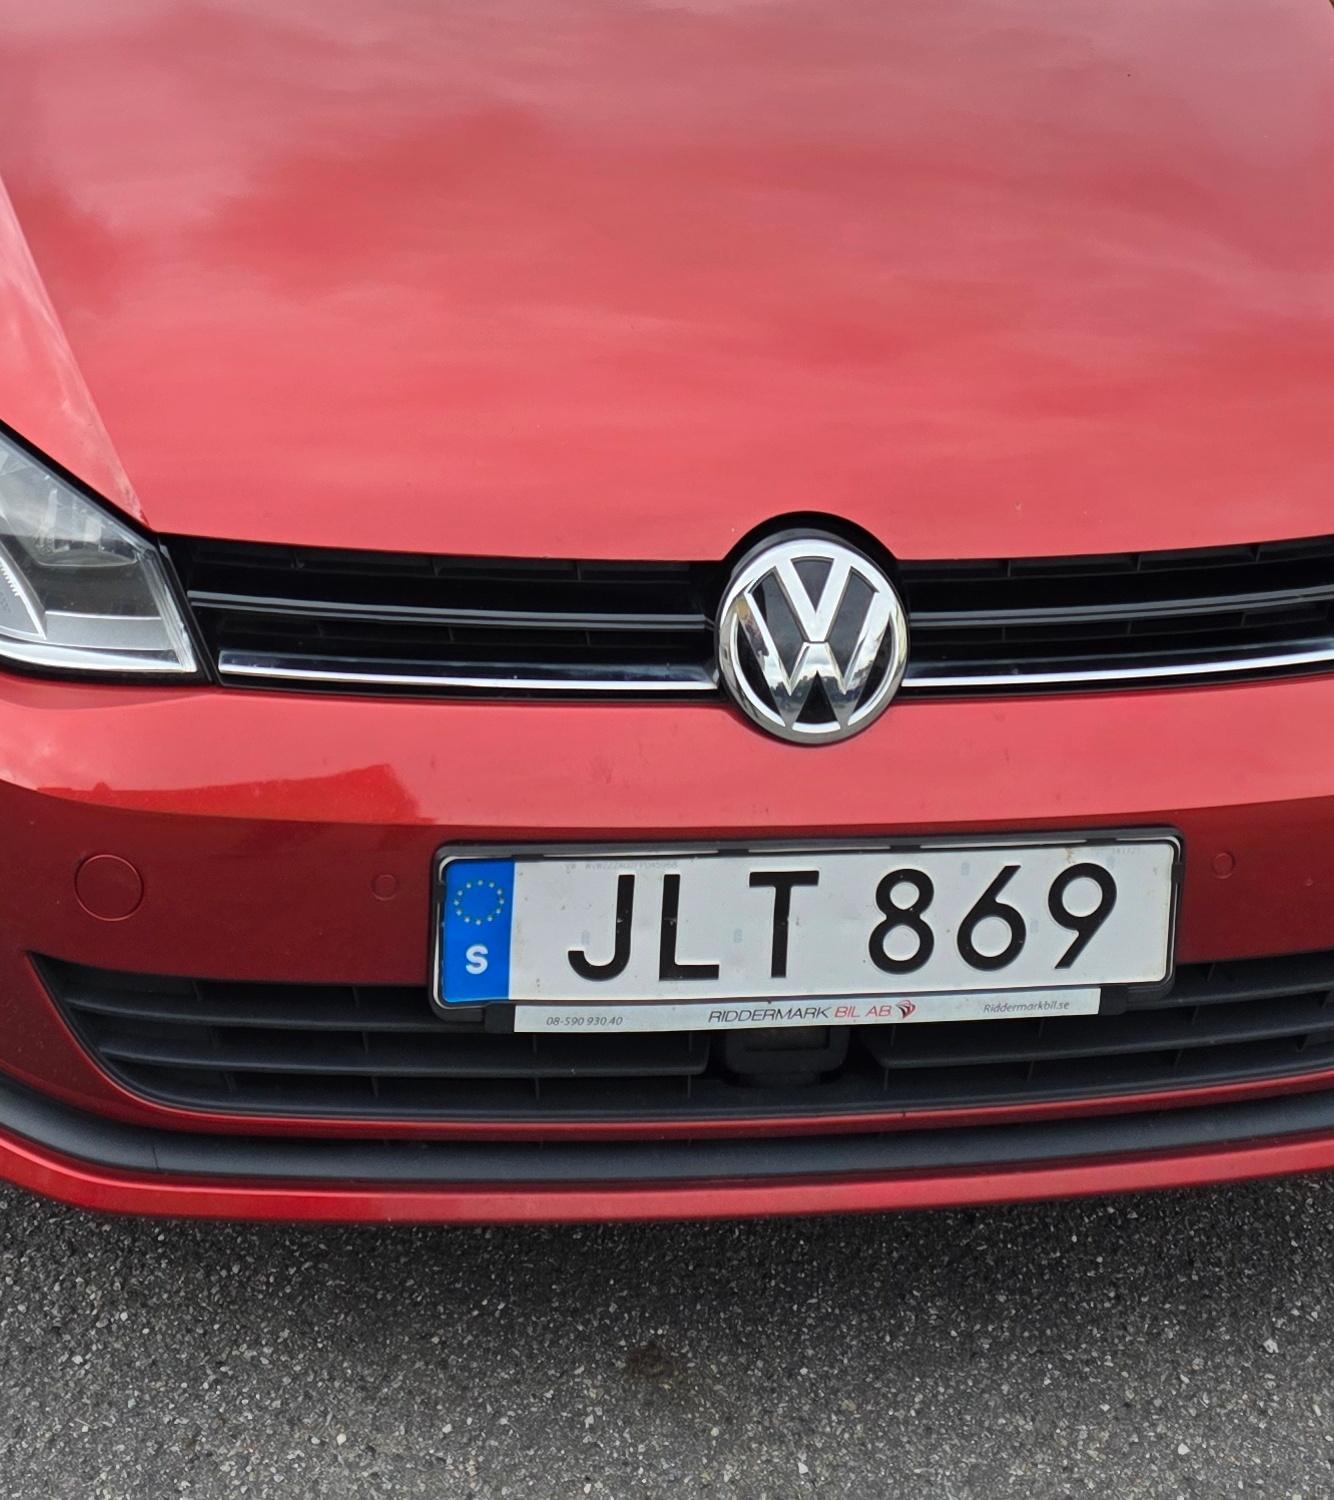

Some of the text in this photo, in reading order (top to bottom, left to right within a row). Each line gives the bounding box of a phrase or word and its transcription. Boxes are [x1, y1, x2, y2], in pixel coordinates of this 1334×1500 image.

[567, 862, 1117, 981] JLT 869
[466, 944, 488, 975] S
[546, 1016, 585, 1026] 08-590
[708, 1005, 892, 1023] RIDDERMARK BIL AB
